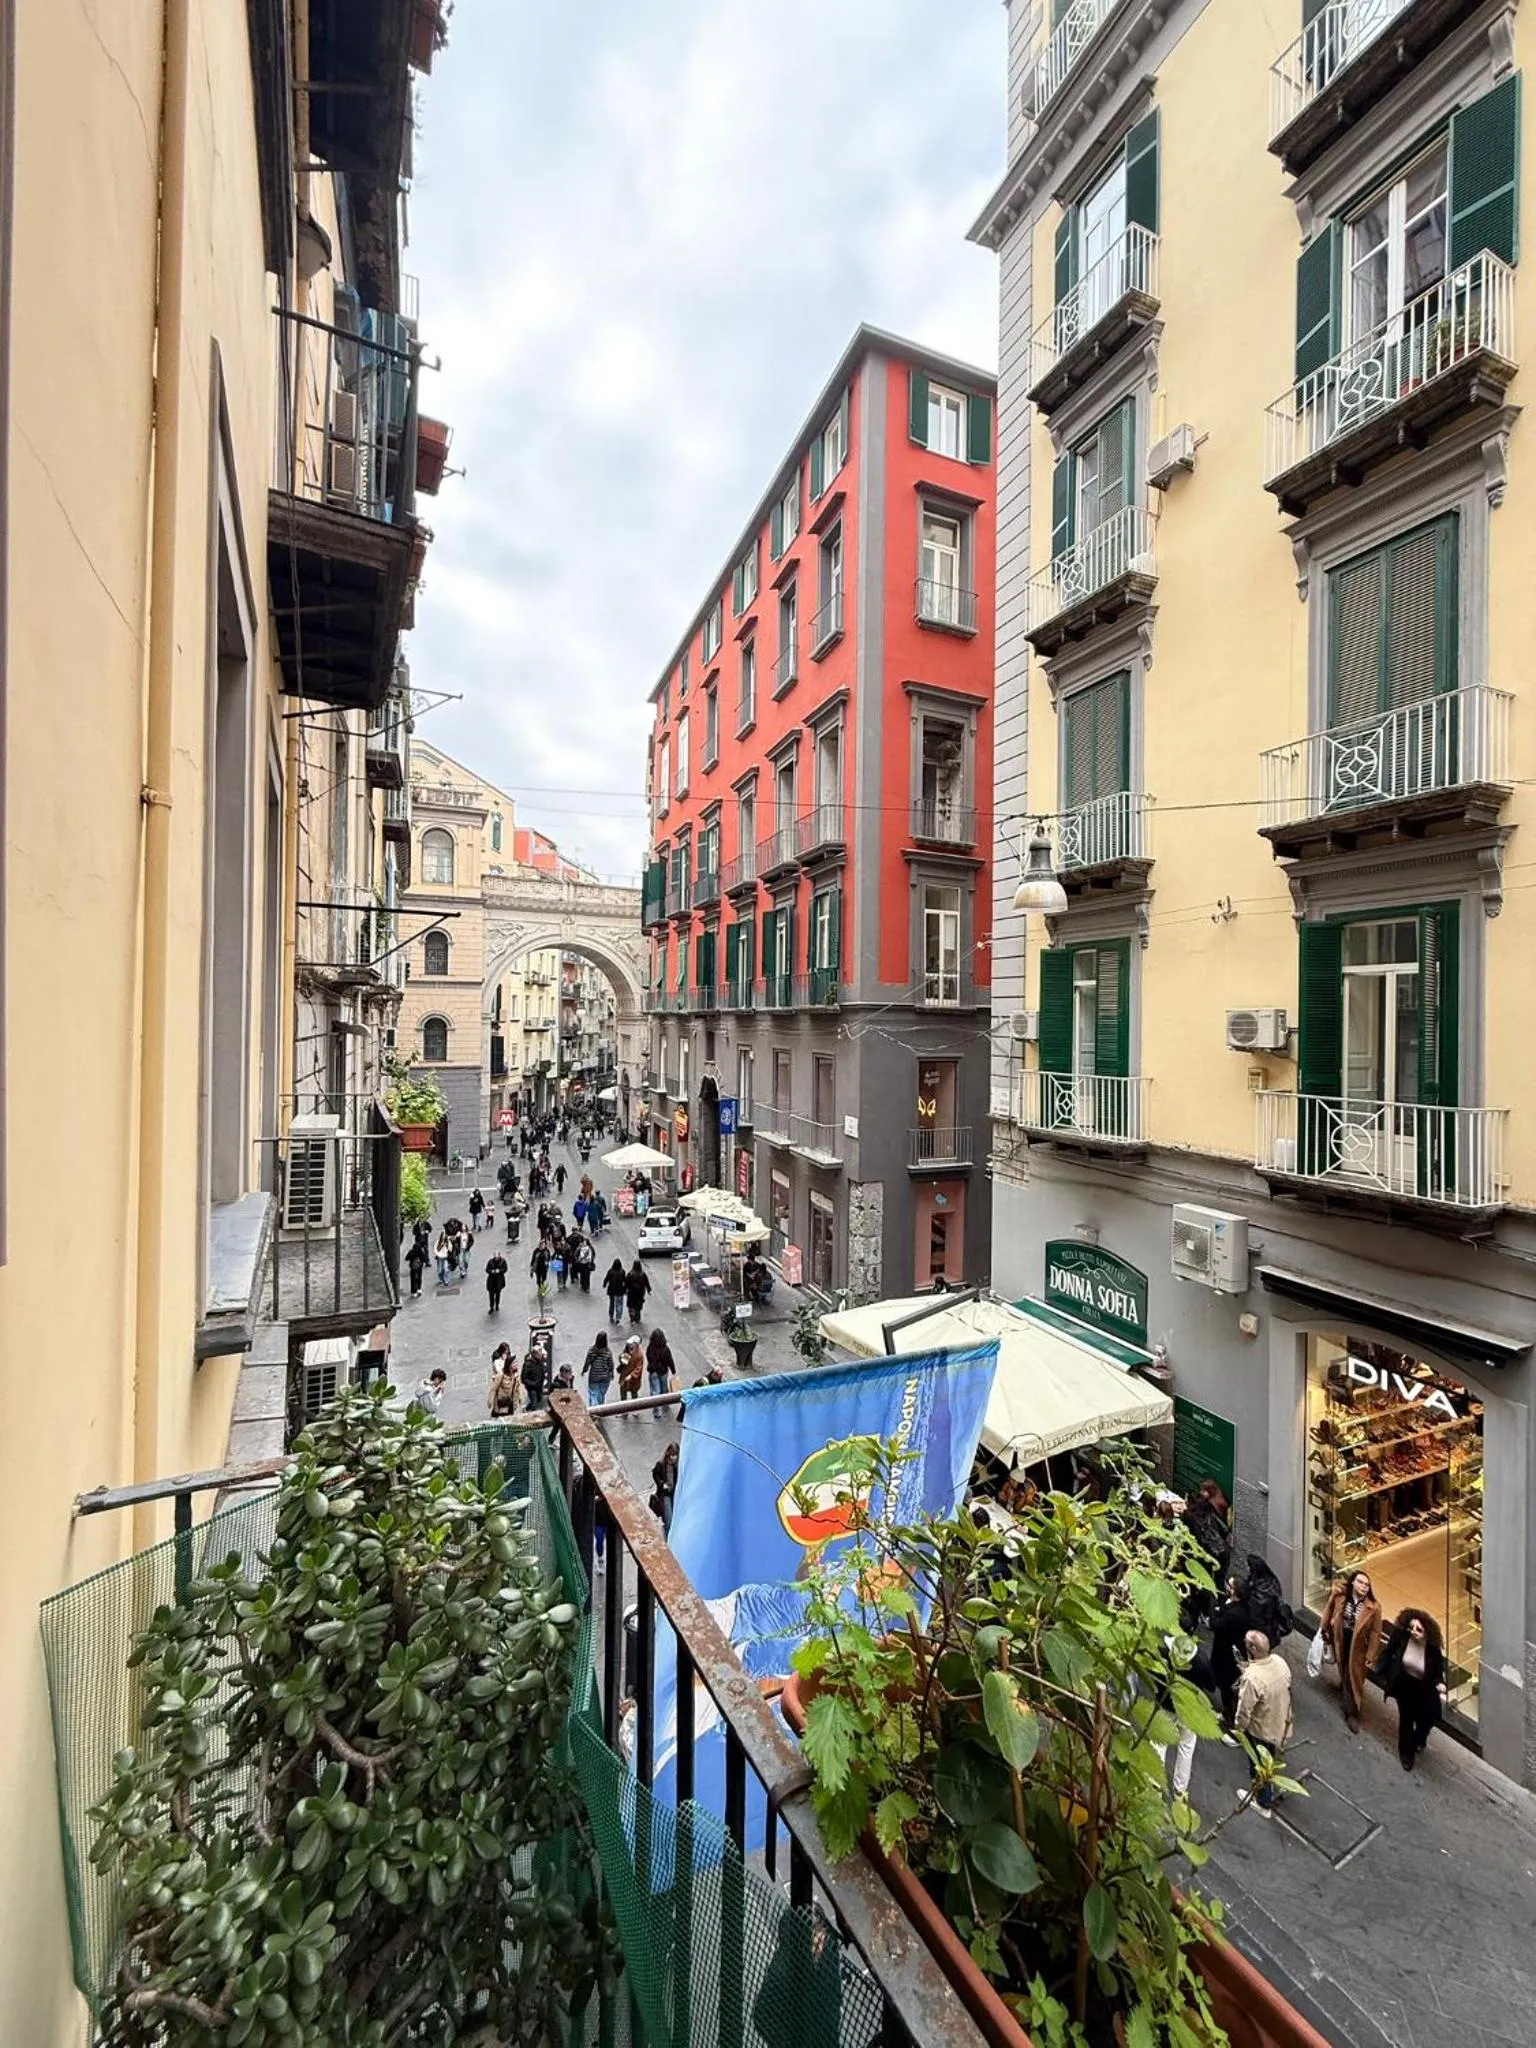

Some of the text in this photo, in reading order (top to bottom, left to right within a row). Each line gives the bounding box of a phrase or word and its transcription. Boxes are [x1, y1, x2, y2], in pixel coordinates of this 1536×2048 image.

[499, 1113, 512, 1123] M
[1049, 1265, 1139, 1325] DONNA SOFIA
[1347, 1356, 1459, 1420] DIVA
